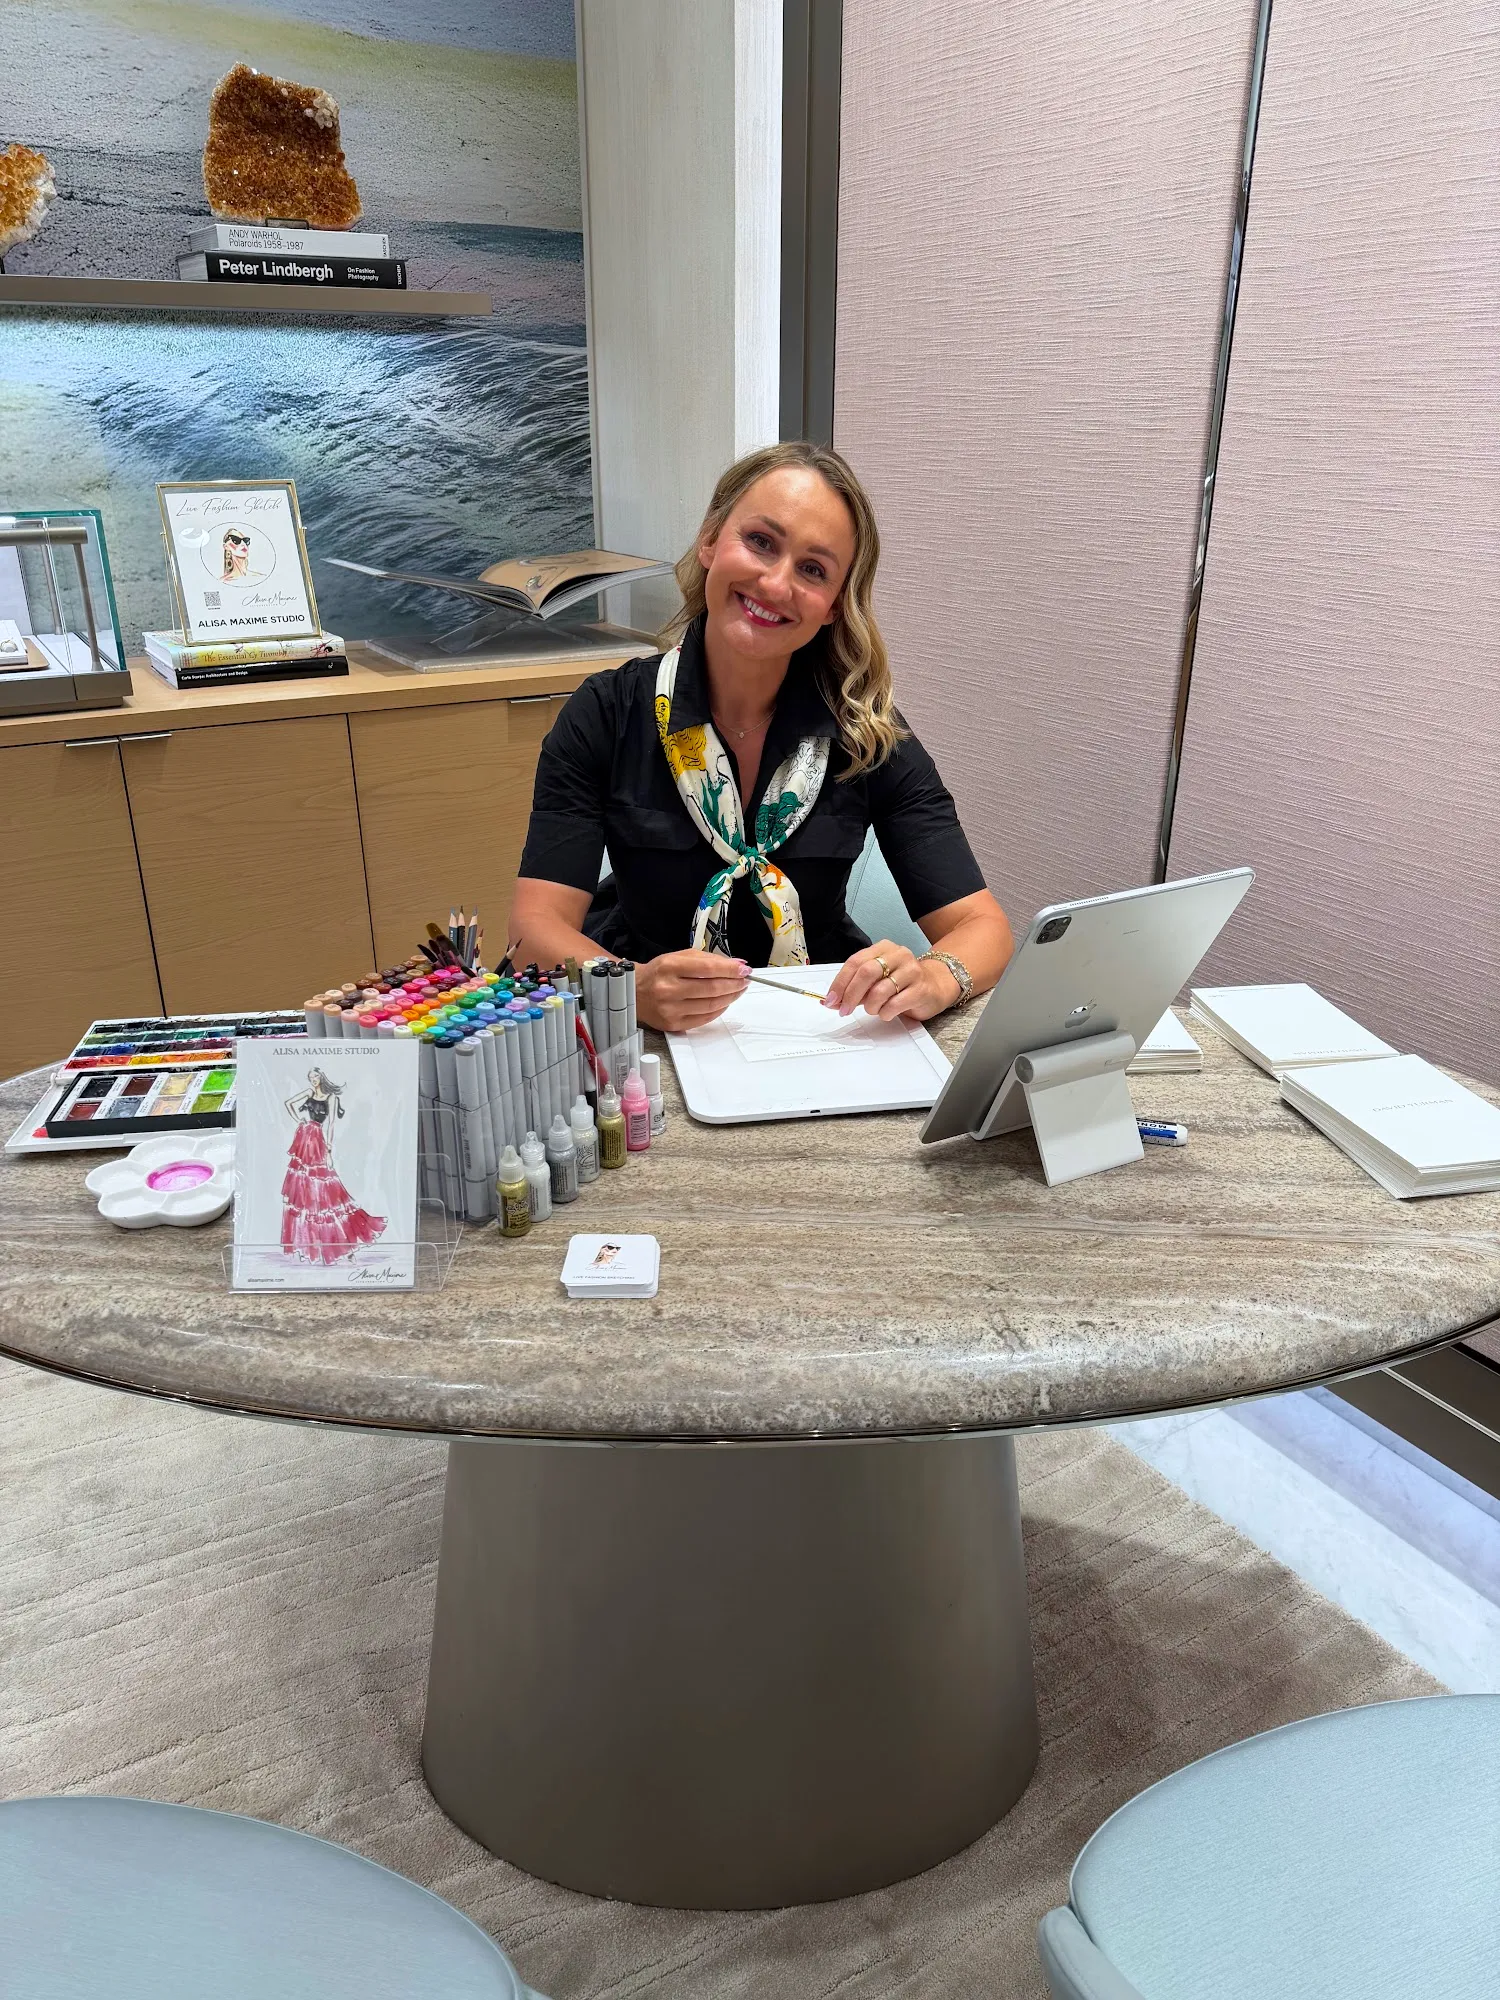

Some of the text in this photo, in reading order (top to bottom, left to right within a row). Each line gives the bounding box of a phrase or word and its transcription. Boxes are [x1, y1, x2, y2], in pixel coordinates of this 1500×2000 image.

[229, 229, 283, 240] ANDY WARHOL
[229, 238, 262, 248] Polaroids
[219, 258, 334, 281] Peter Lindbergh
[347, 273, 379, 281] Photography
[244, 496, 282, 515] Sketch
[198, 614, 305, 628] ALISA MAXIME STUDIO
[202, 652, 216, 662] The
[218, 651, 247, 661] Essential
[272, 1047, 380, 1056] ALISA MAXIME STUDIO
